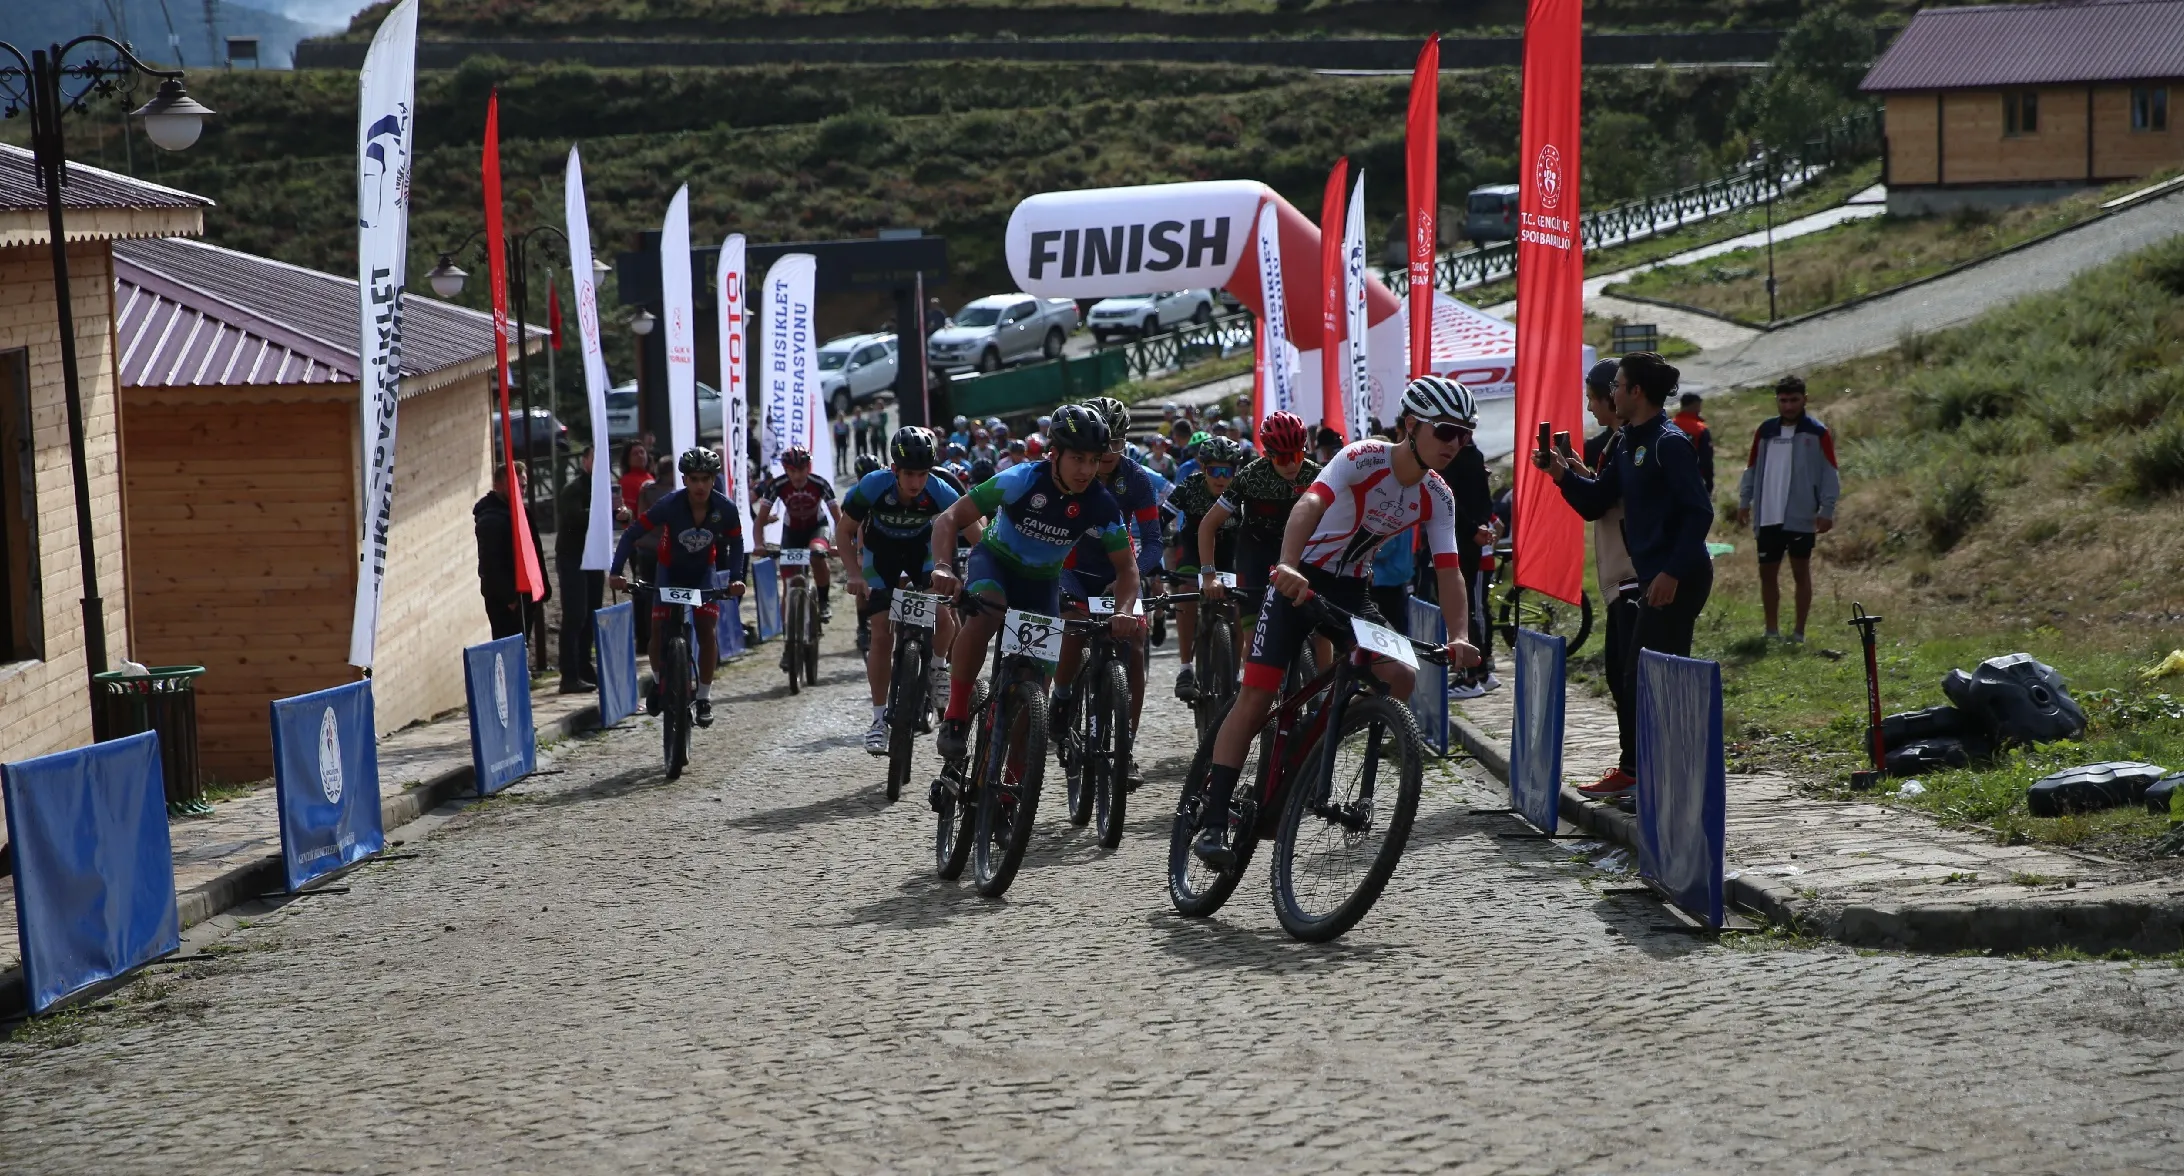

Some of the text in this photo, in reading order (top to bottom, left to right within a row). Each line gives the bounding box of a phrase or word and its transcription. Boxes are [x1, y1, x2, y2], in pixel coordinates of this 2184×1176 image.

[1028, 217, 1230, 280] FINISH
[727, 272, 741, 392] TOTO
[771, 280, 788, 373] BİSİKLET
[791, 302, 808, 446] FEDERASYONU
[1427, 479, 1448, 501] Cycling
[1015, 523, 1072, 546] RİZESPOR
[1023, 517, 1070, 537] ÇAYKUR
[669, 591, 692, 601] 64
[901, 598, 925, 618] 68
[1101, 600, 1115, 609] 6
[1017, 622, 1050, 649] 62
[1371, 630, 1402, 655] 61
[1274, 842, 1282, 887] BARZO
